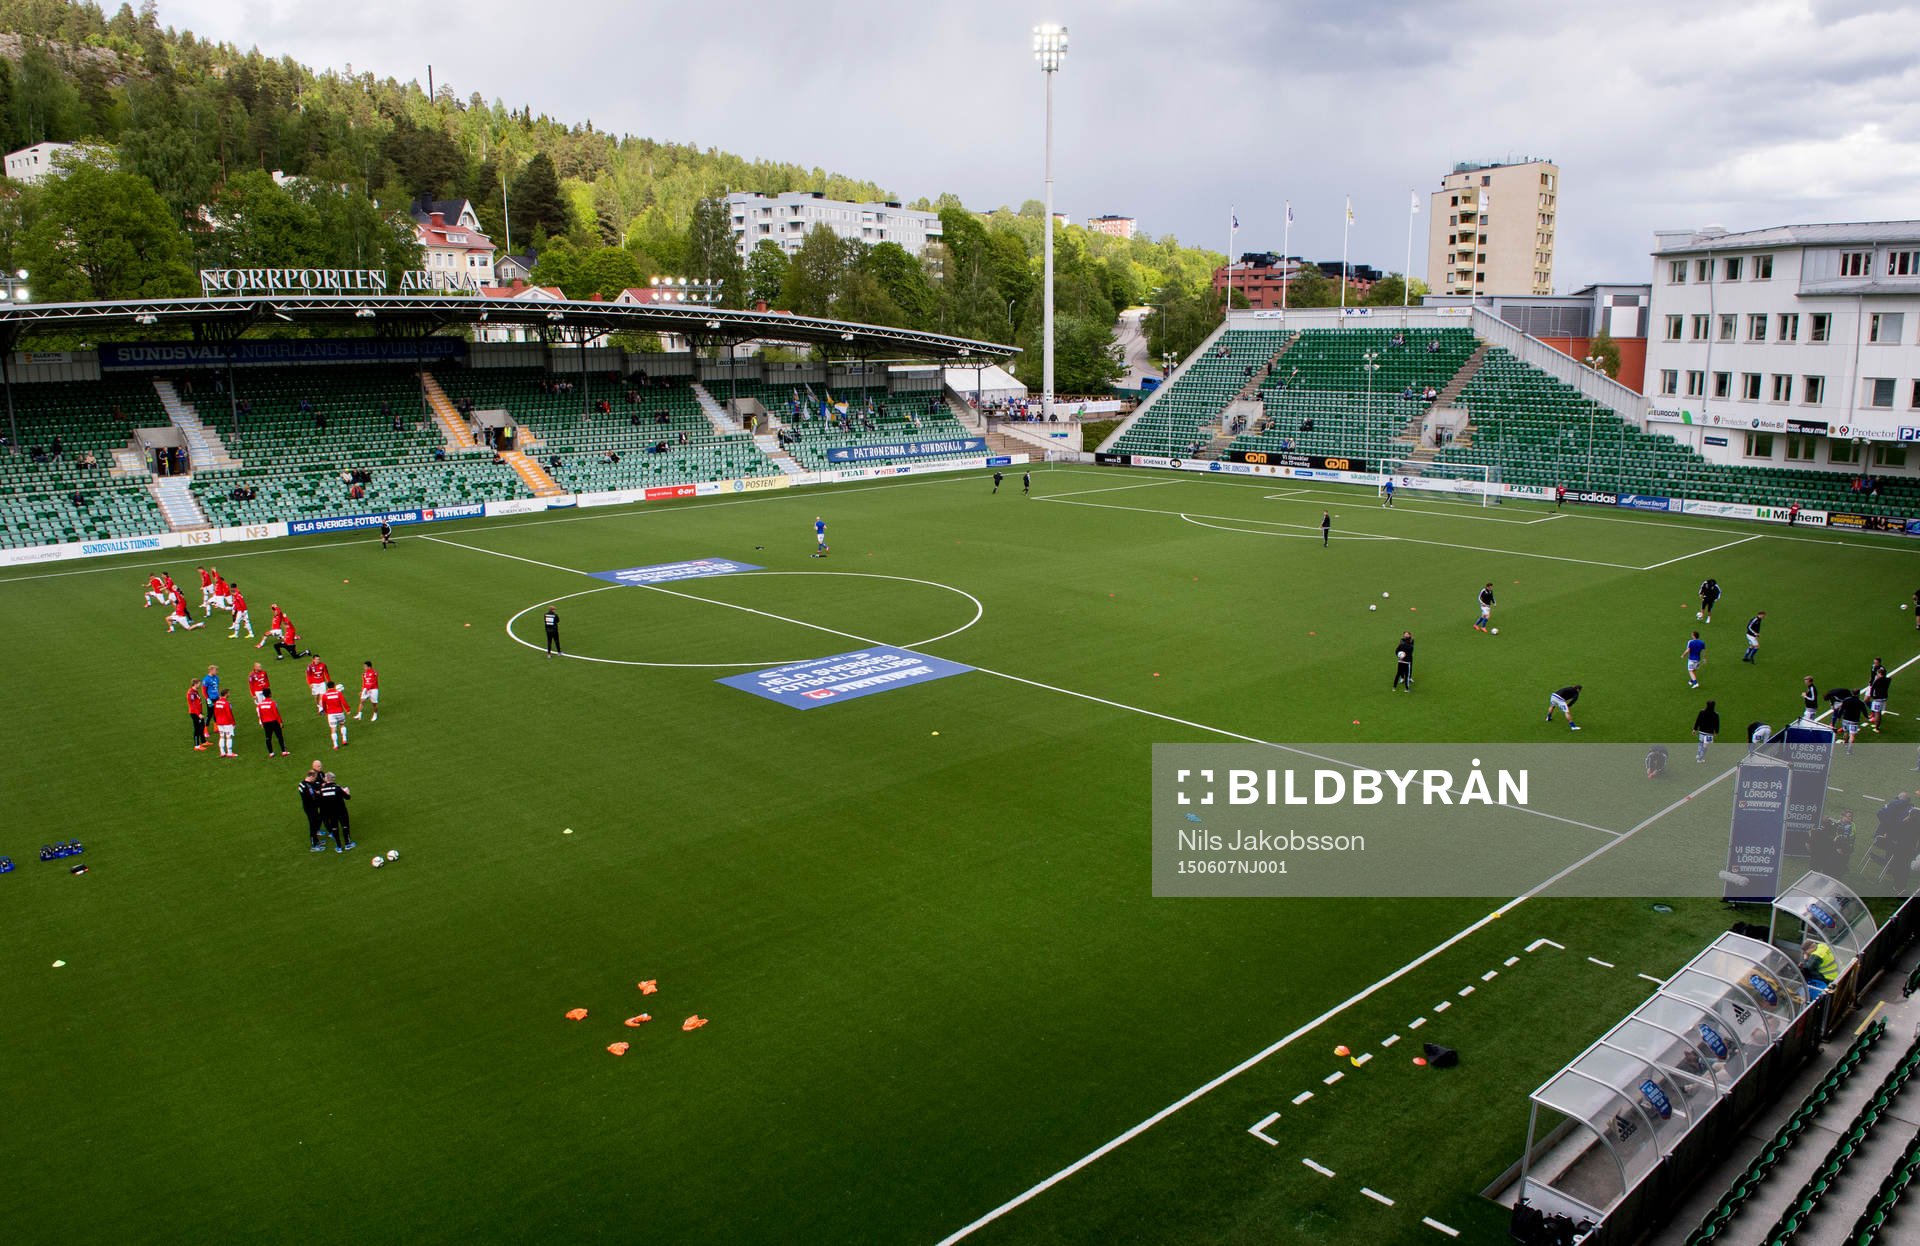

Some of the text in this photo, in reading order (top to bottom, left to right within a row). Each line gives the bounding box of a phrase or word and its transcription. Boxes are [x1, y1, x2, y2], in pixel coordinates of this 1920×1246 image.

[200, 269, 480, 290] NORRPORTEN ARENA
[1653, 410, 1680, 418] EUROCON
[1721, 417, 1748, 426] Protector
[1852, 428, 1896, 438] Protector
[853, 441, 962, 458] PATRONERNA SUNDSVALL
[1509, 484, 1544, 495] PEAB
[1580, 491, 1616, 504] adidas
[1773, 510, 1823, 523] Mihem
[293, 512, 417, 533] HELA SVERIGES FOTBOLLSKLUBB
[82, 538, 160, 555] SUNDSVALLS TIDNING
[758, 654, 901, 687] HELA SVERIGES
[768, 658, 923, 694] FOTBOLLSKLUBB
[1799, 744, 1814, 752] SES
[1791, 751, 1822, 761] LÖRDAG
[1742, 780, 1783, 790] VI SES PÅ
[1744, 789, 1778, 799] LÖRDAG
[1790, 804, 1805, 812] SES
[1786, 811, 1812, 821] ÖRDAG
[1735, 845, 1775, 855] VI SES PÅ
[1737, 853, 1770, 864] LÖRDAG
